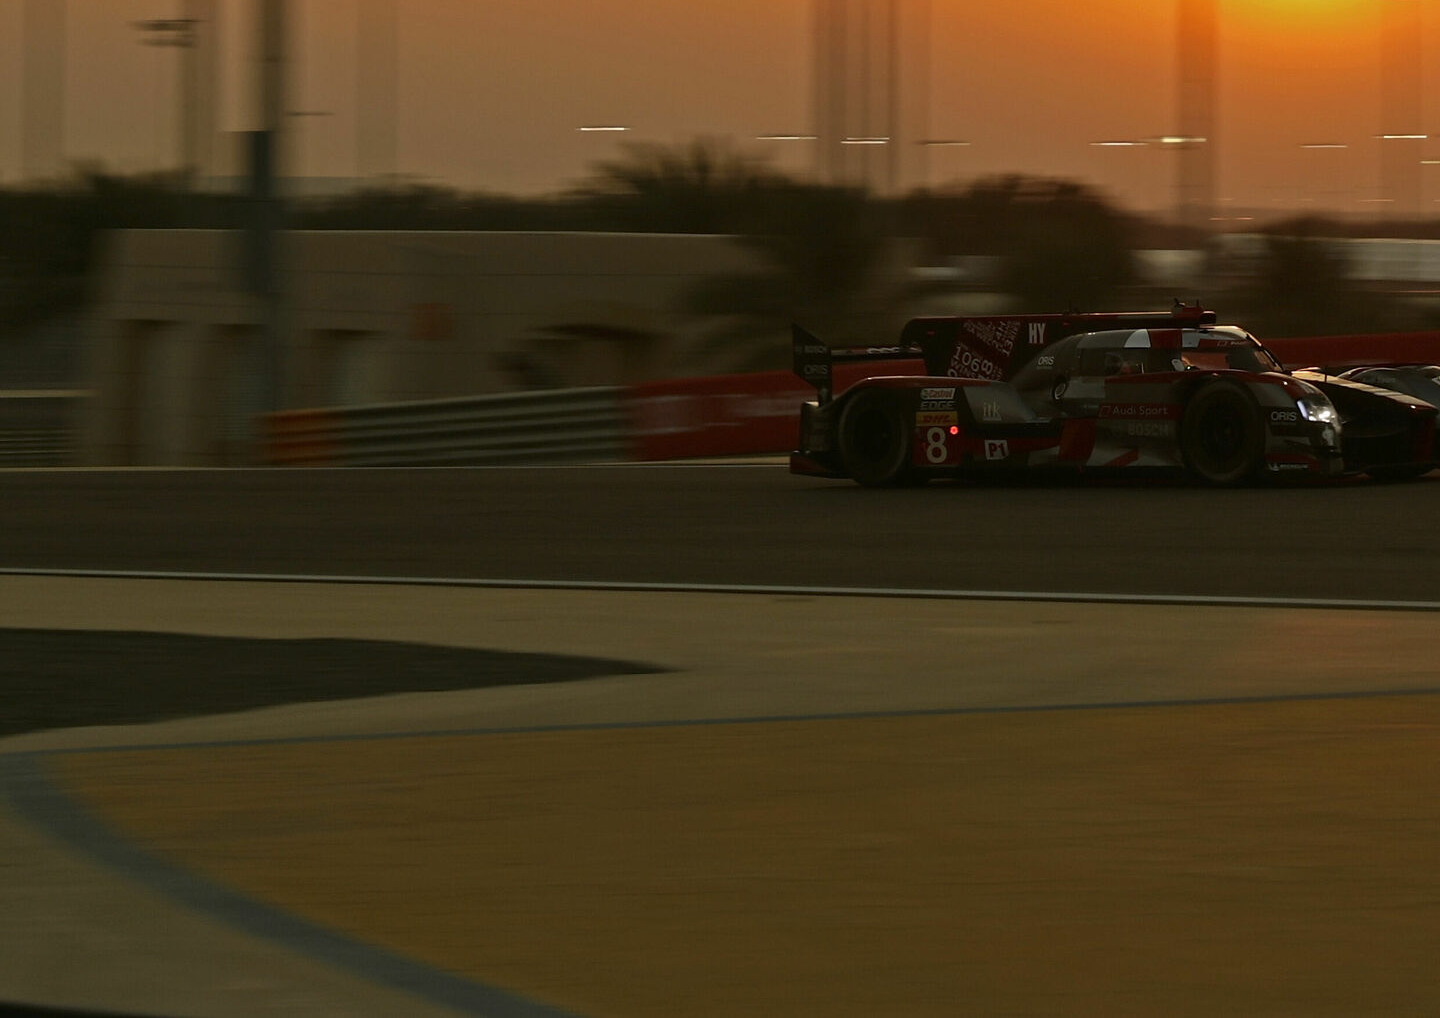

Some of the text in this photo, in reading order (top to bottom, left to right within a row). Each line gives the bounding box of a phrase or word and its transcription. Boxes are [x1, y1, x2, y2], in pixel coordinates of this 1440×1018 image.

[1028, 322, 1046, 344] HY
[804, 364, 829, 375] ORIS
[920, 401, 955, 410] EDGE
[1112, 406, 1168, 417] Audi Sport
[1271, 410, 1298, 421] ORIS
[926, 427, 947, 463] 8
[989, 442, 1006, 458] P1
